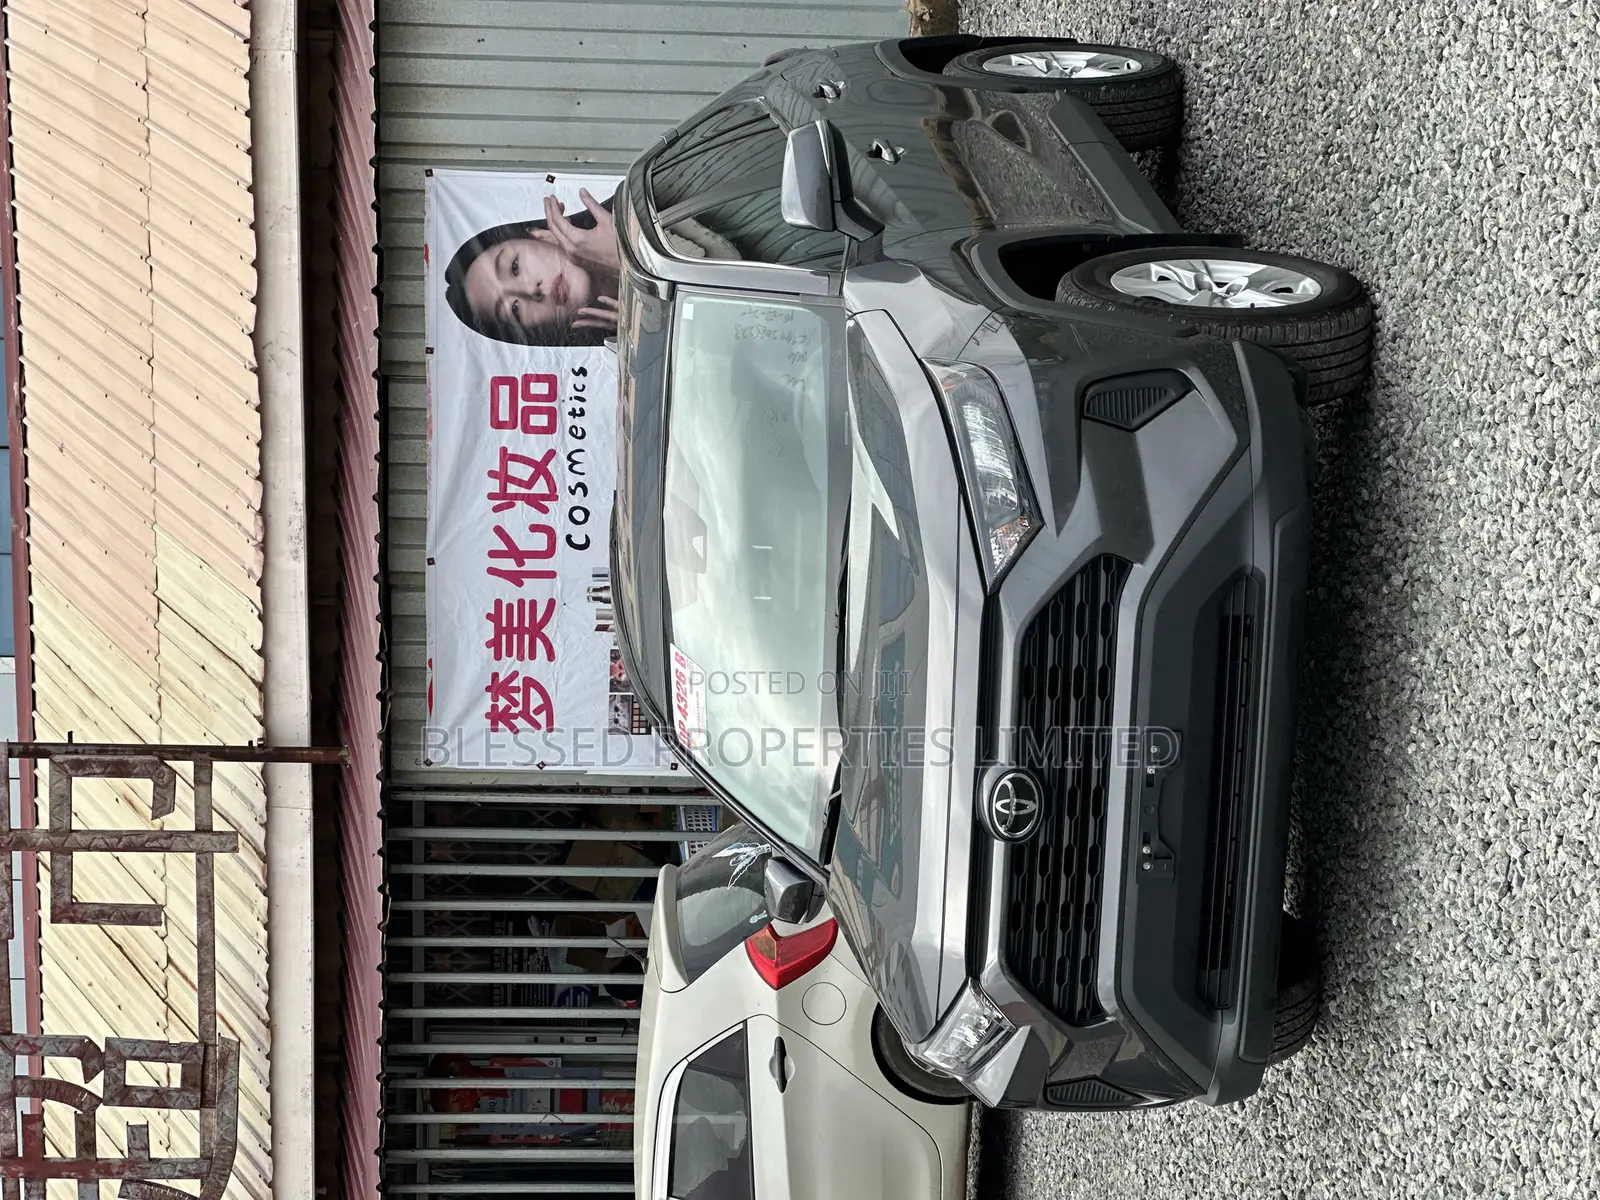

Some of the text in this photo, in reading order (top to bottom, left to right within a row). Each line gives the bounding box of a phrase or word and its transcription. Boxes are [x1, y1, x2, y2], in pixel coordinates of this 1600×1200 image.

[485, 373, 559, 734] 梦美化妆品
[675, 651, 687, 669] B
[675, 668, 688, 721] 4326
